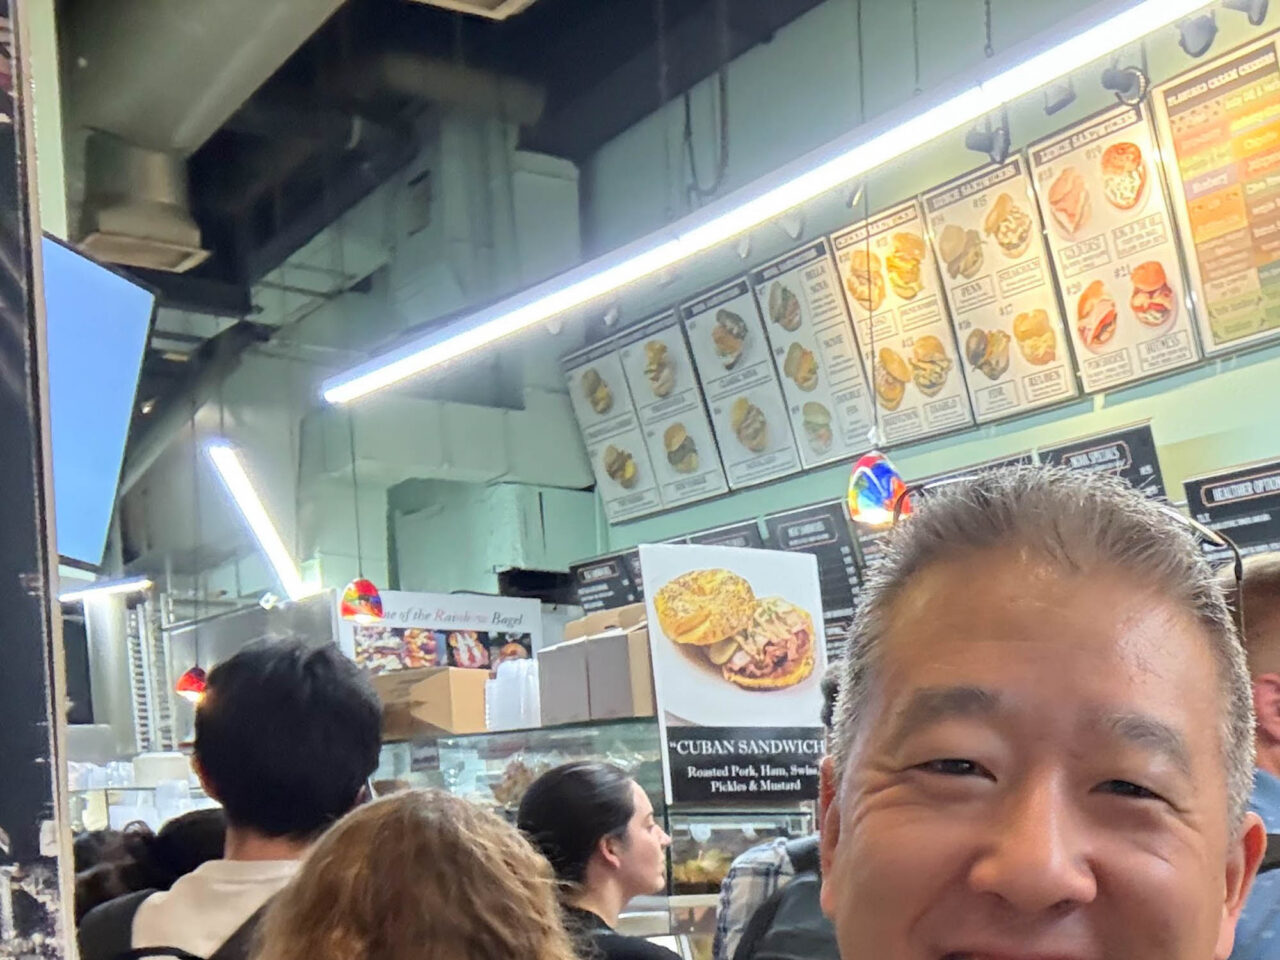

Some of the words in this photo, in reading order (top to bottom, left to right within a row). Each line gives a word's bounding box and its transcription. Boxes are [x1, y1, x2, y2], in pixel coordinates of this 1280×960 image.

[400, 606, 411, 623] of
[412, 609, 432, 621] the
[491, 611, 523, 629] Bagel
[738, 739, 826, 755] SANDWICH
[687, 765, 729, 779] Roasted
[731, 765, 758, 779] Pork,
[760, 765, 789, 778] Ham,
[711, 780, 747, 793] Pickles
[748, 781, 758, 792] &
[759, 779, 801, 792] Mustard
